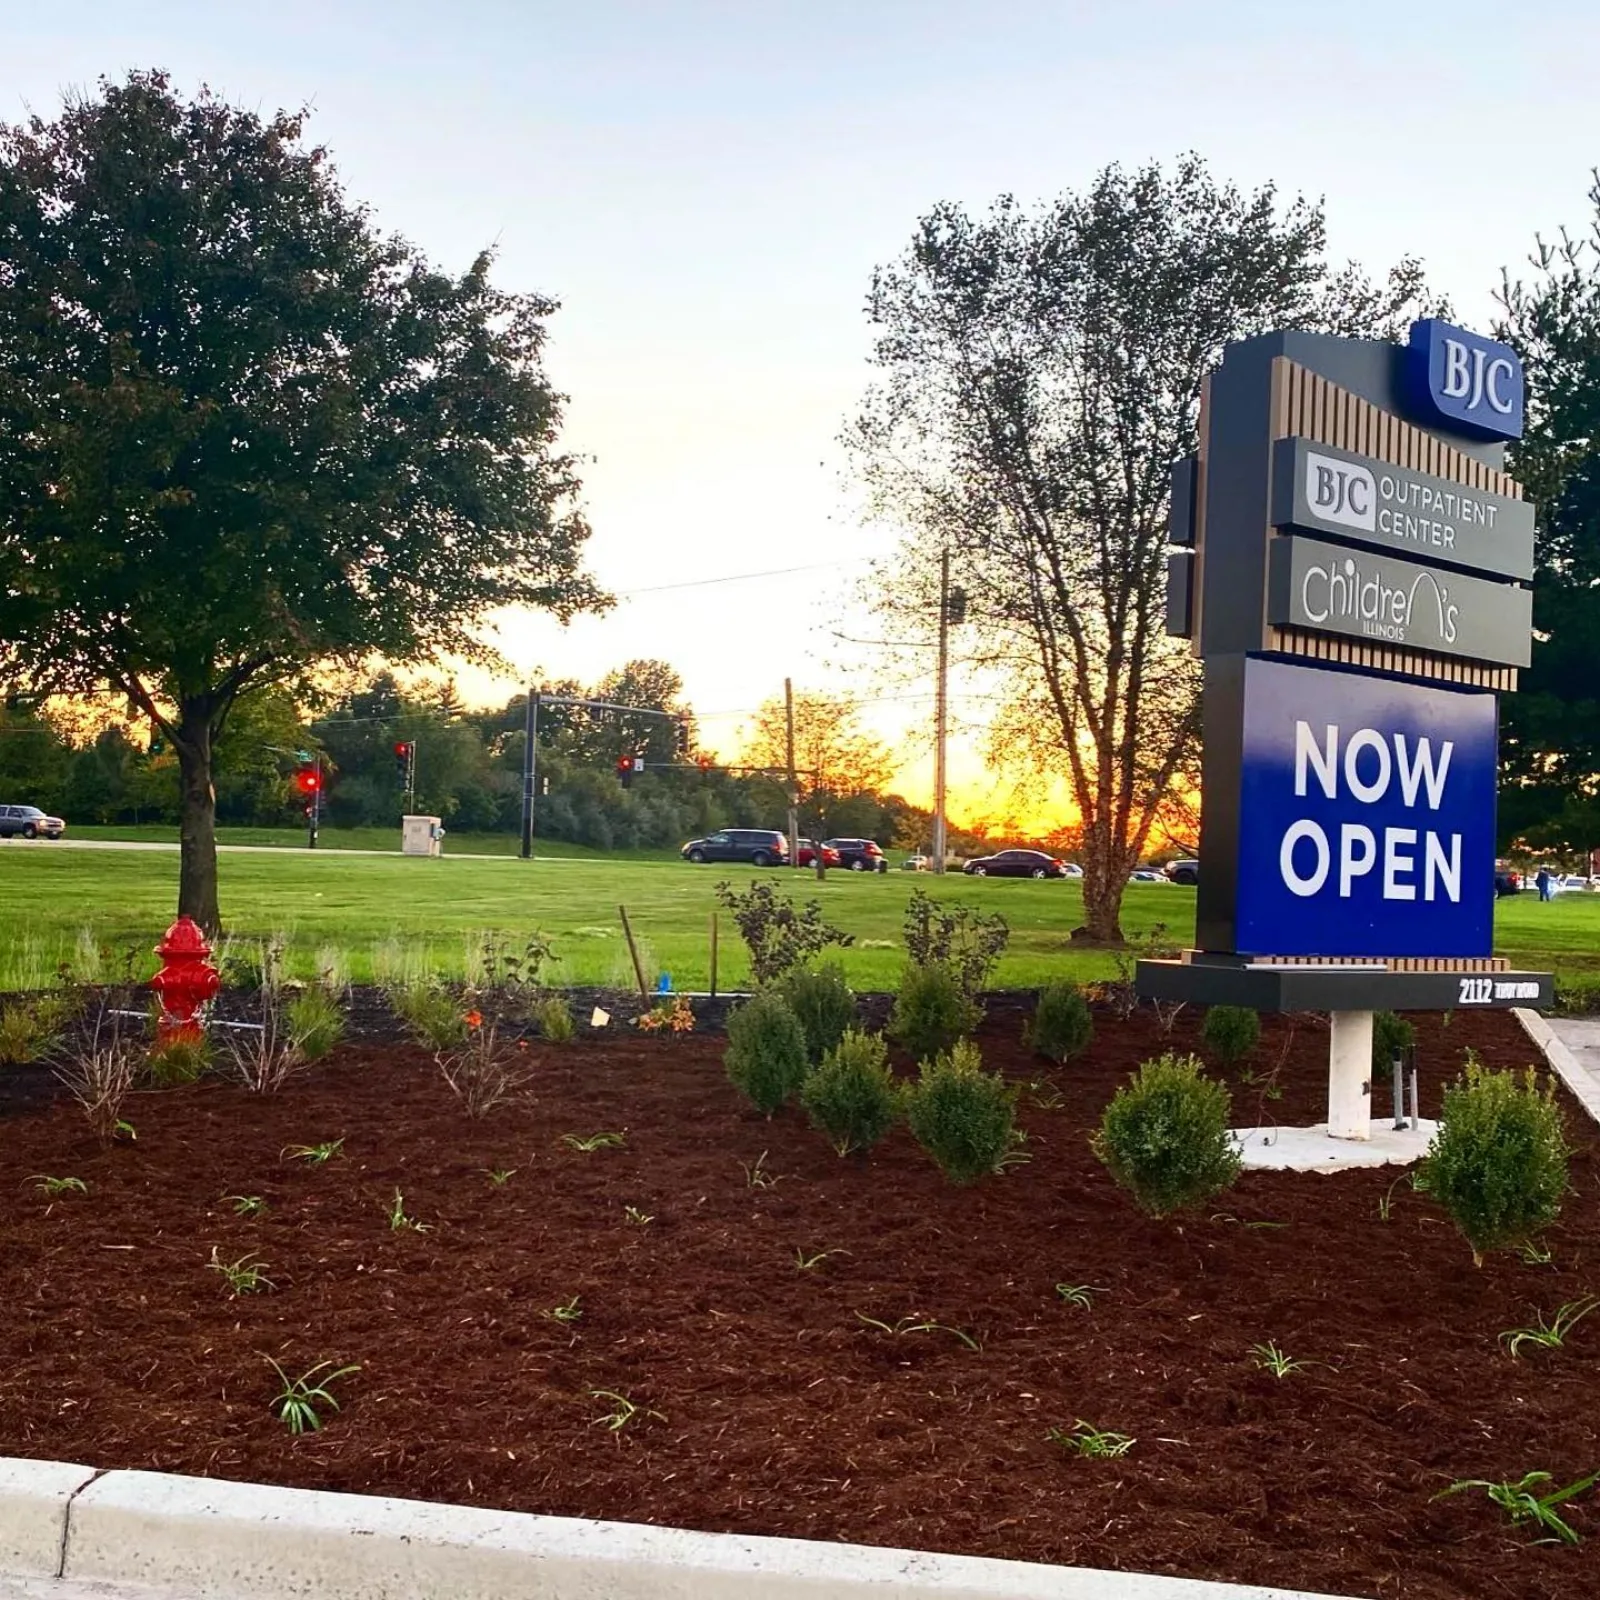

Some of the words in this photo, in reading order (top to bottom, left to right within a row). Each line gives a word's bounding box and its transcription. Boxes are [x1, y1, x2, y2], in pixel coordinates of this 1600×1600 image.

[1443, 338, 1513, 414] BJC
[1315, 465, 1368, 516] BJC
[1380, 476, 1498, 528] OUTPATIENT
[1378, 509, 1455, 549] CENTER
[1362, 620, 1405, 641] ILLINOIS
[1295, 720, 1454, 810] NOW
[1280, 819, 1462, 902] OPEN
[1459, 978, 1492, 1003] 2112
